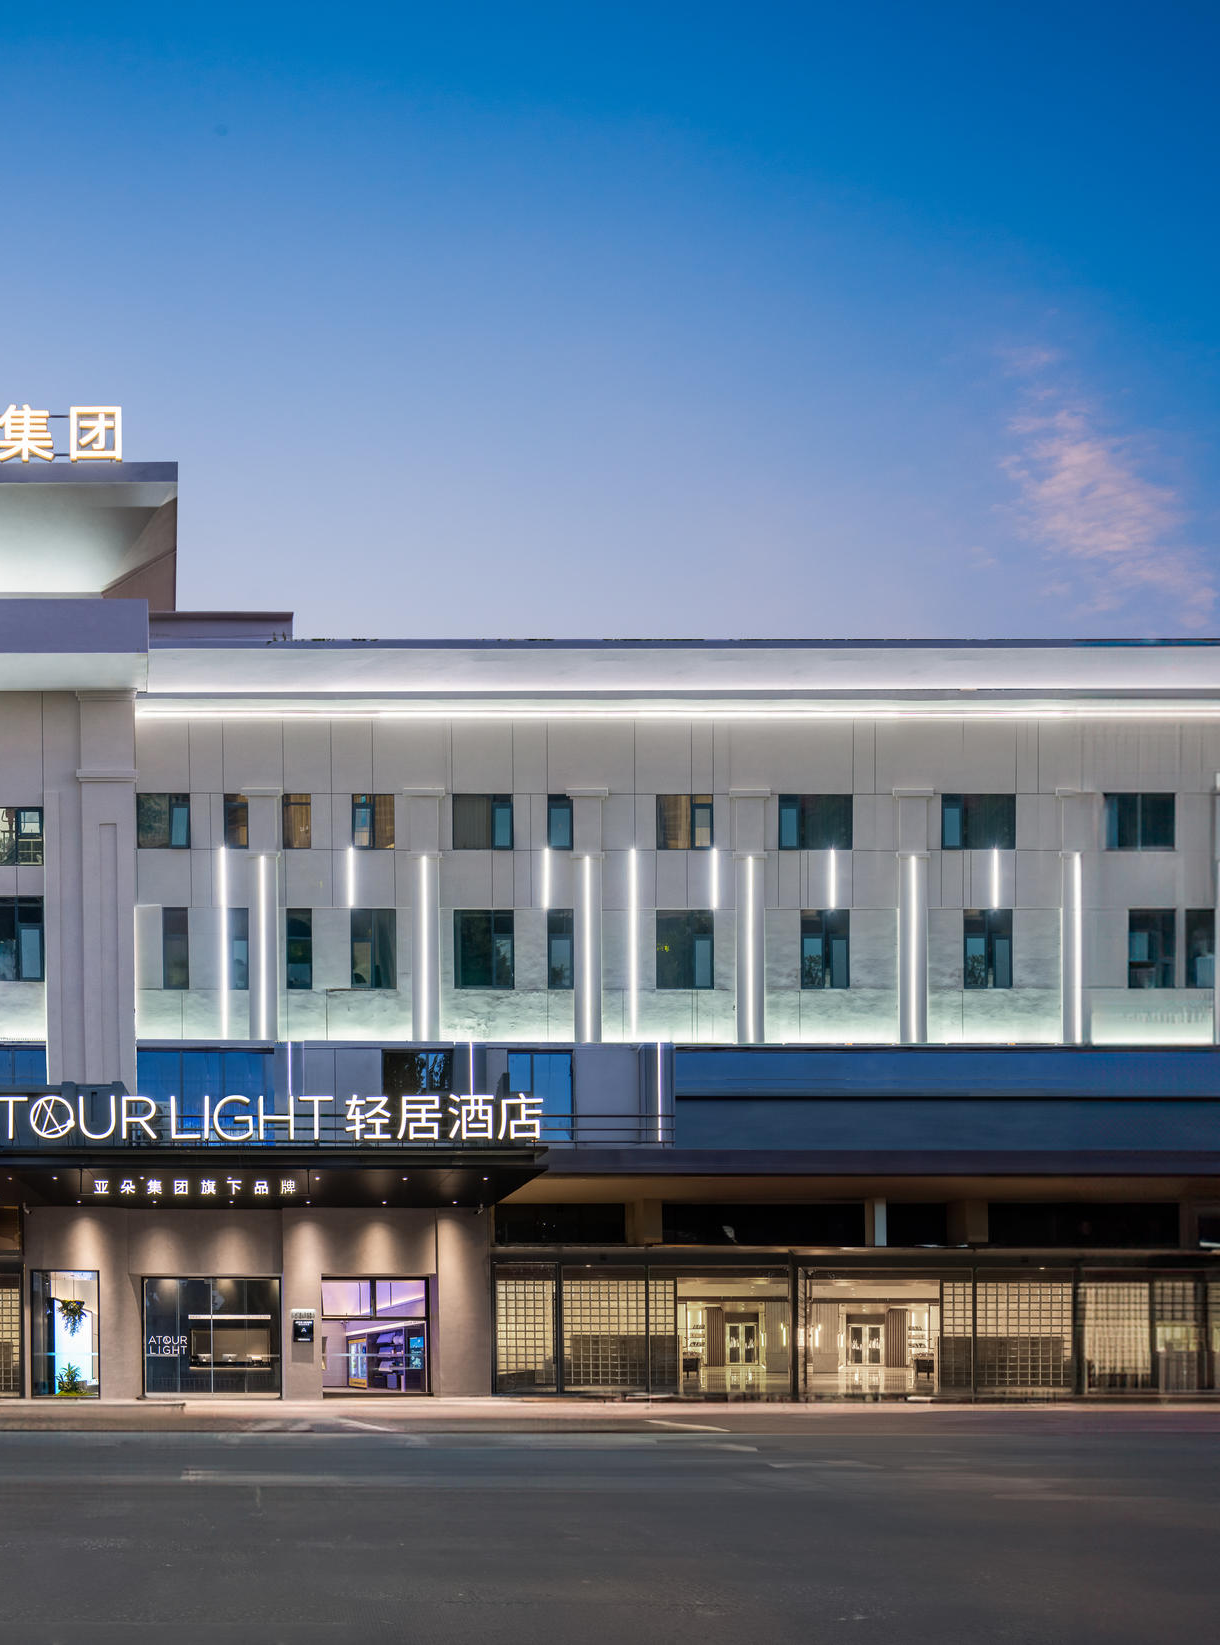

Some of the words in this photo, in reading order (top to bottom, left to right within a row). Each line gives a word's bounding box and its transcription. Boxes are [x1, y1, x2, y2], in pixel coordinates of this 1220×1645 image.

[170, 1094, 334, 1141] LIGHT
[344, 1093, 544, 1141] 轻居酒店
[93, 1179, 296, 1196] 亚朵集团旗下品牌
[148, 1335, 188, 1345] ATOUR
[149, 1345, 188, 1355] LIGHT
